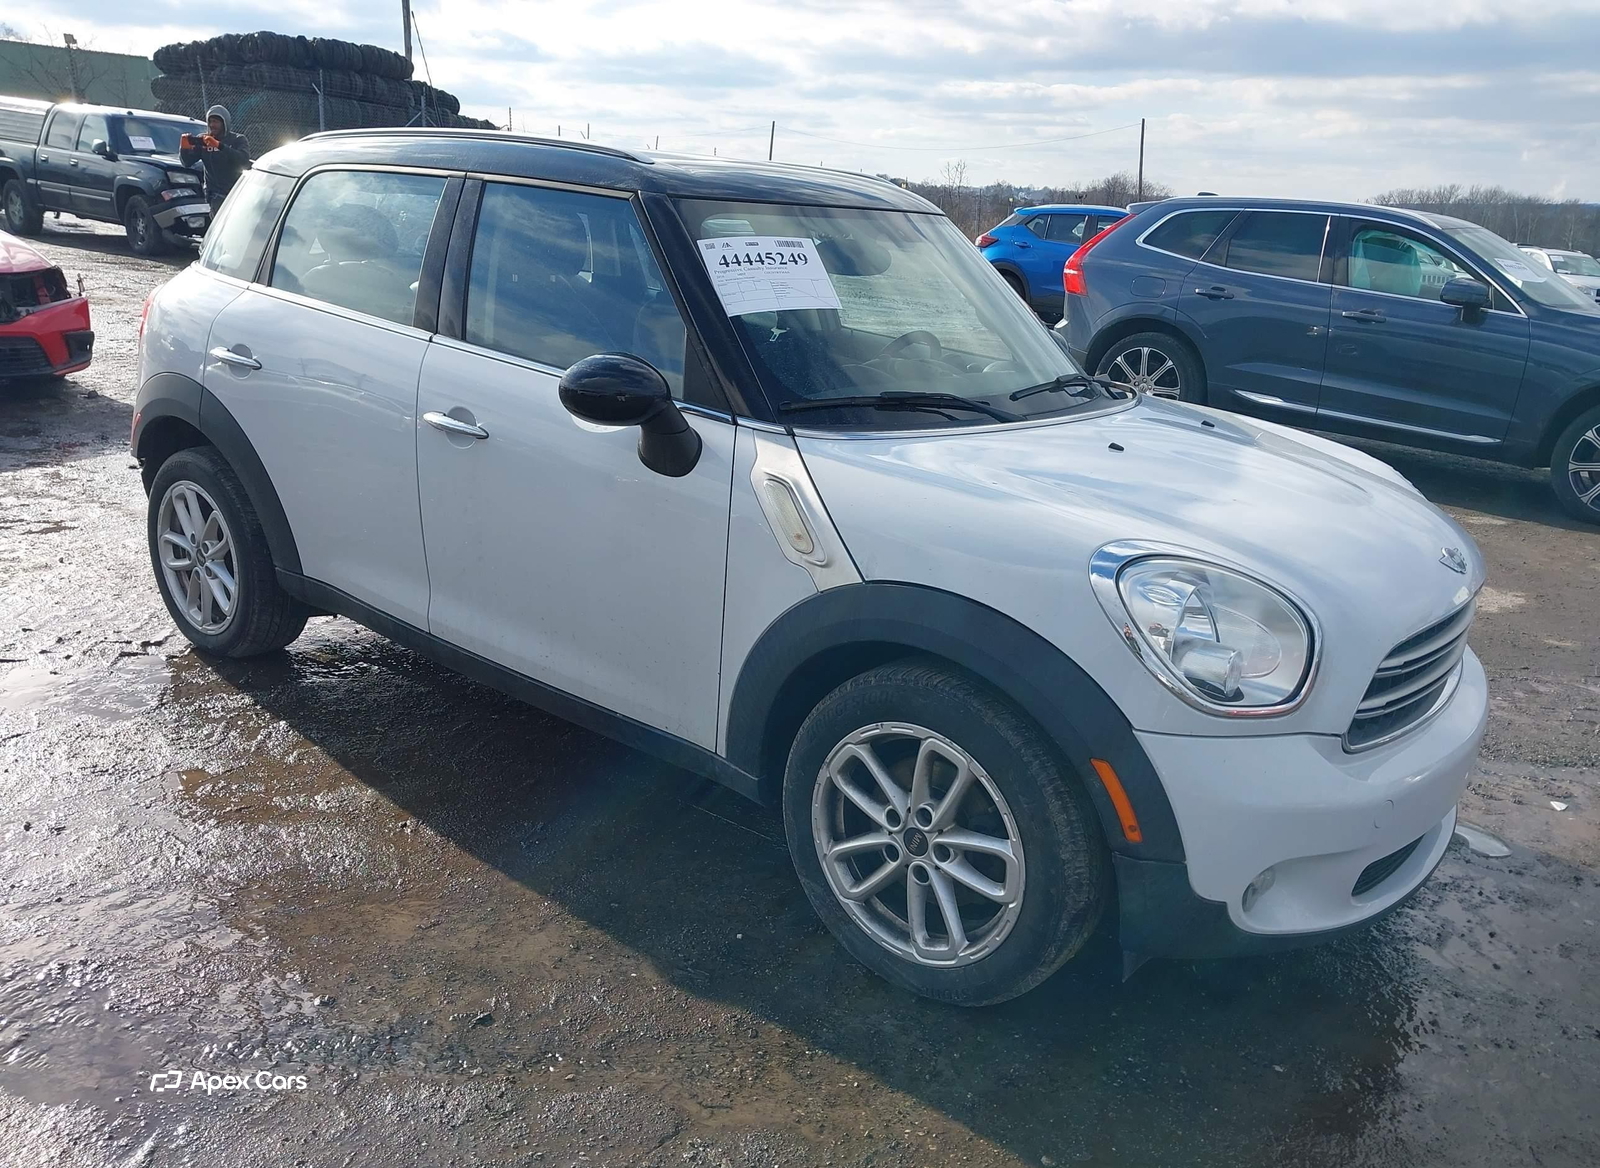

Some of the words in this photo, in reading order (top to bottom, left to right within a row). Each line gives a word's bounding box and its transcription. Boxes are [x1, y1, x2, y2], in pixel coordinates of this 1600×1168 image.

[718, 252, 808, 268] 44445249
[714, 267, 742, 275] Progressive
[908, 832, 923, 852] MINI
